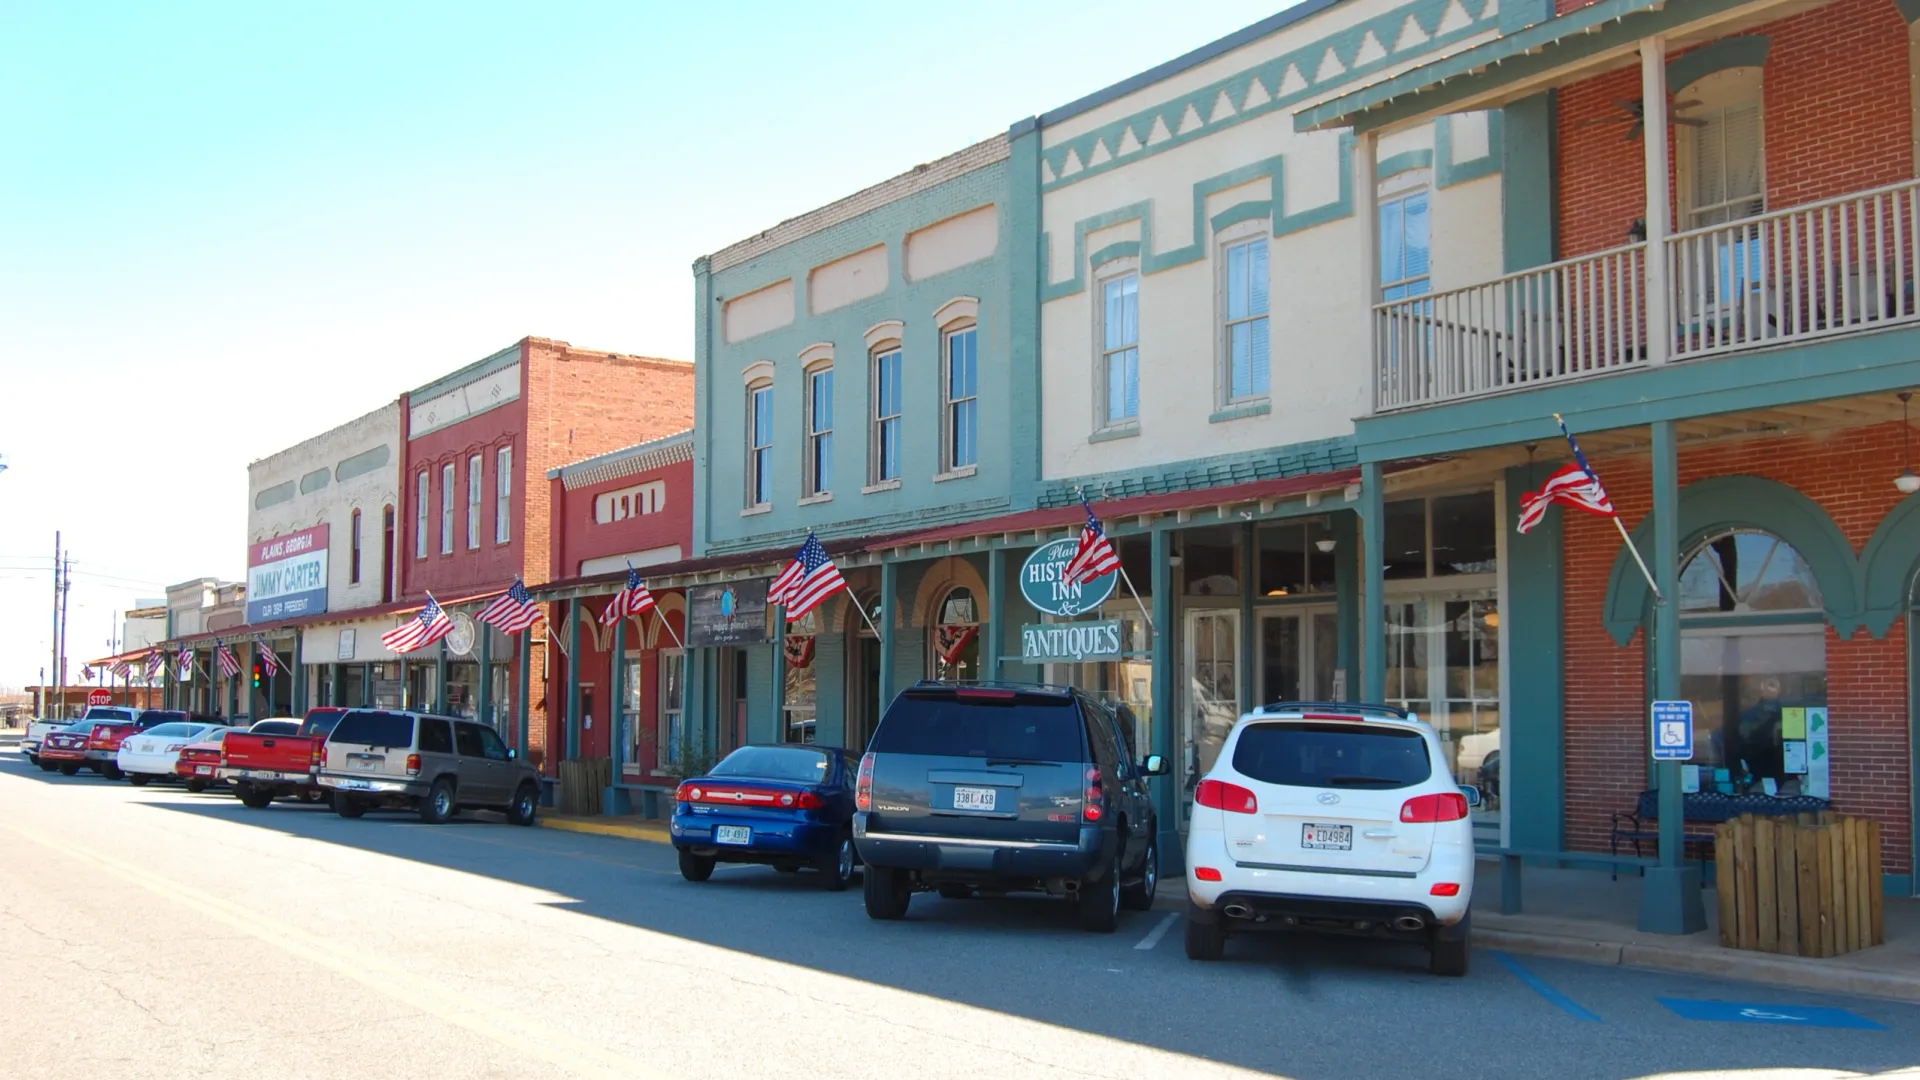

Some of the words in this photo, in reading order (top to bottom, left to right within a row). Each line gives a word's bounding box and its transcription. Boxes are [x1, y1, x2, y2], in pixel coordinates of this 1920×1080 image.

[611, 488, 656, 522] 1901
[253, 571, 282, 597] JIMMY
[284, 561, 320, 592] CARTER
[1052, 581, 1081, 601] INN
[1057, 601, 1080, 616] &
[1024, 624, 1119, 660] ANTIQUES
[90, 695, 112, 705] STOP
